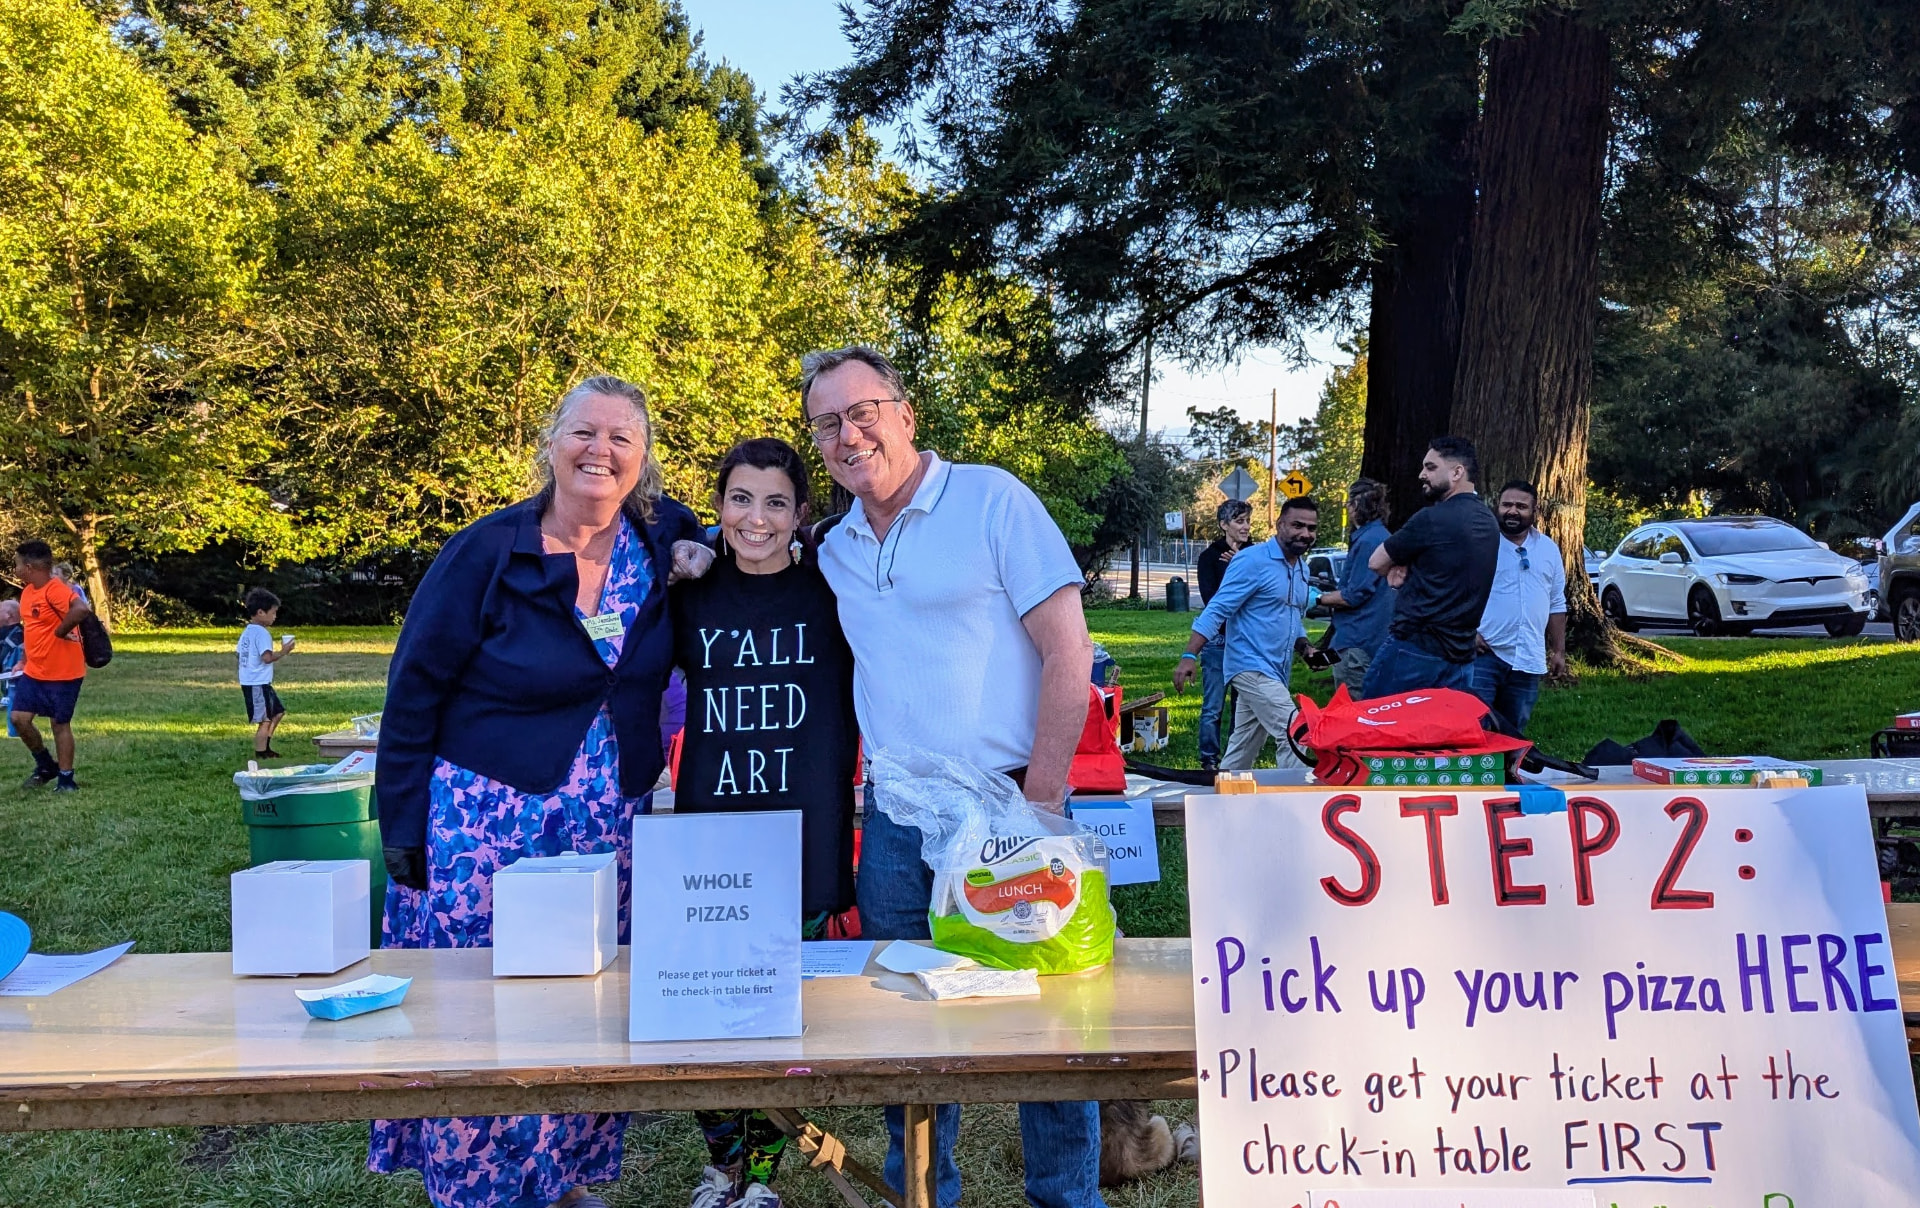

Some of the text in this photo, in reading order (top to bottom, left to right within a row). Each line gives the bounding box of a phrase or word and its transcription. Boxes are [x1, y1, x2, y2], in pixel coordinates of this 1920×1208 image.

[698, 623, 815, 669] Y'ALL
[702, 683, 807, 733] NEED
[713, 747, 794, 796] ART
[1109, 845, 1143, 860] RONI
[1320, 794, 1758, 910] STEP 2:
[682, 872, 753, 891] WHOLE
[998, 883, 1043, 898] LUNCH
[686, 904, 750, 923] PIZZAS
[658, 967, 777, 981] Please get your ticket at
[662, 984, 773, 997] the check-in table first
[1216, 932, 1898, 1040] Pick up your pizza HERE
[1218, 1048, 1840, 1114] Please get your ticket at the
[1242, 1120, 1722, 1178] check-in table FIRST
